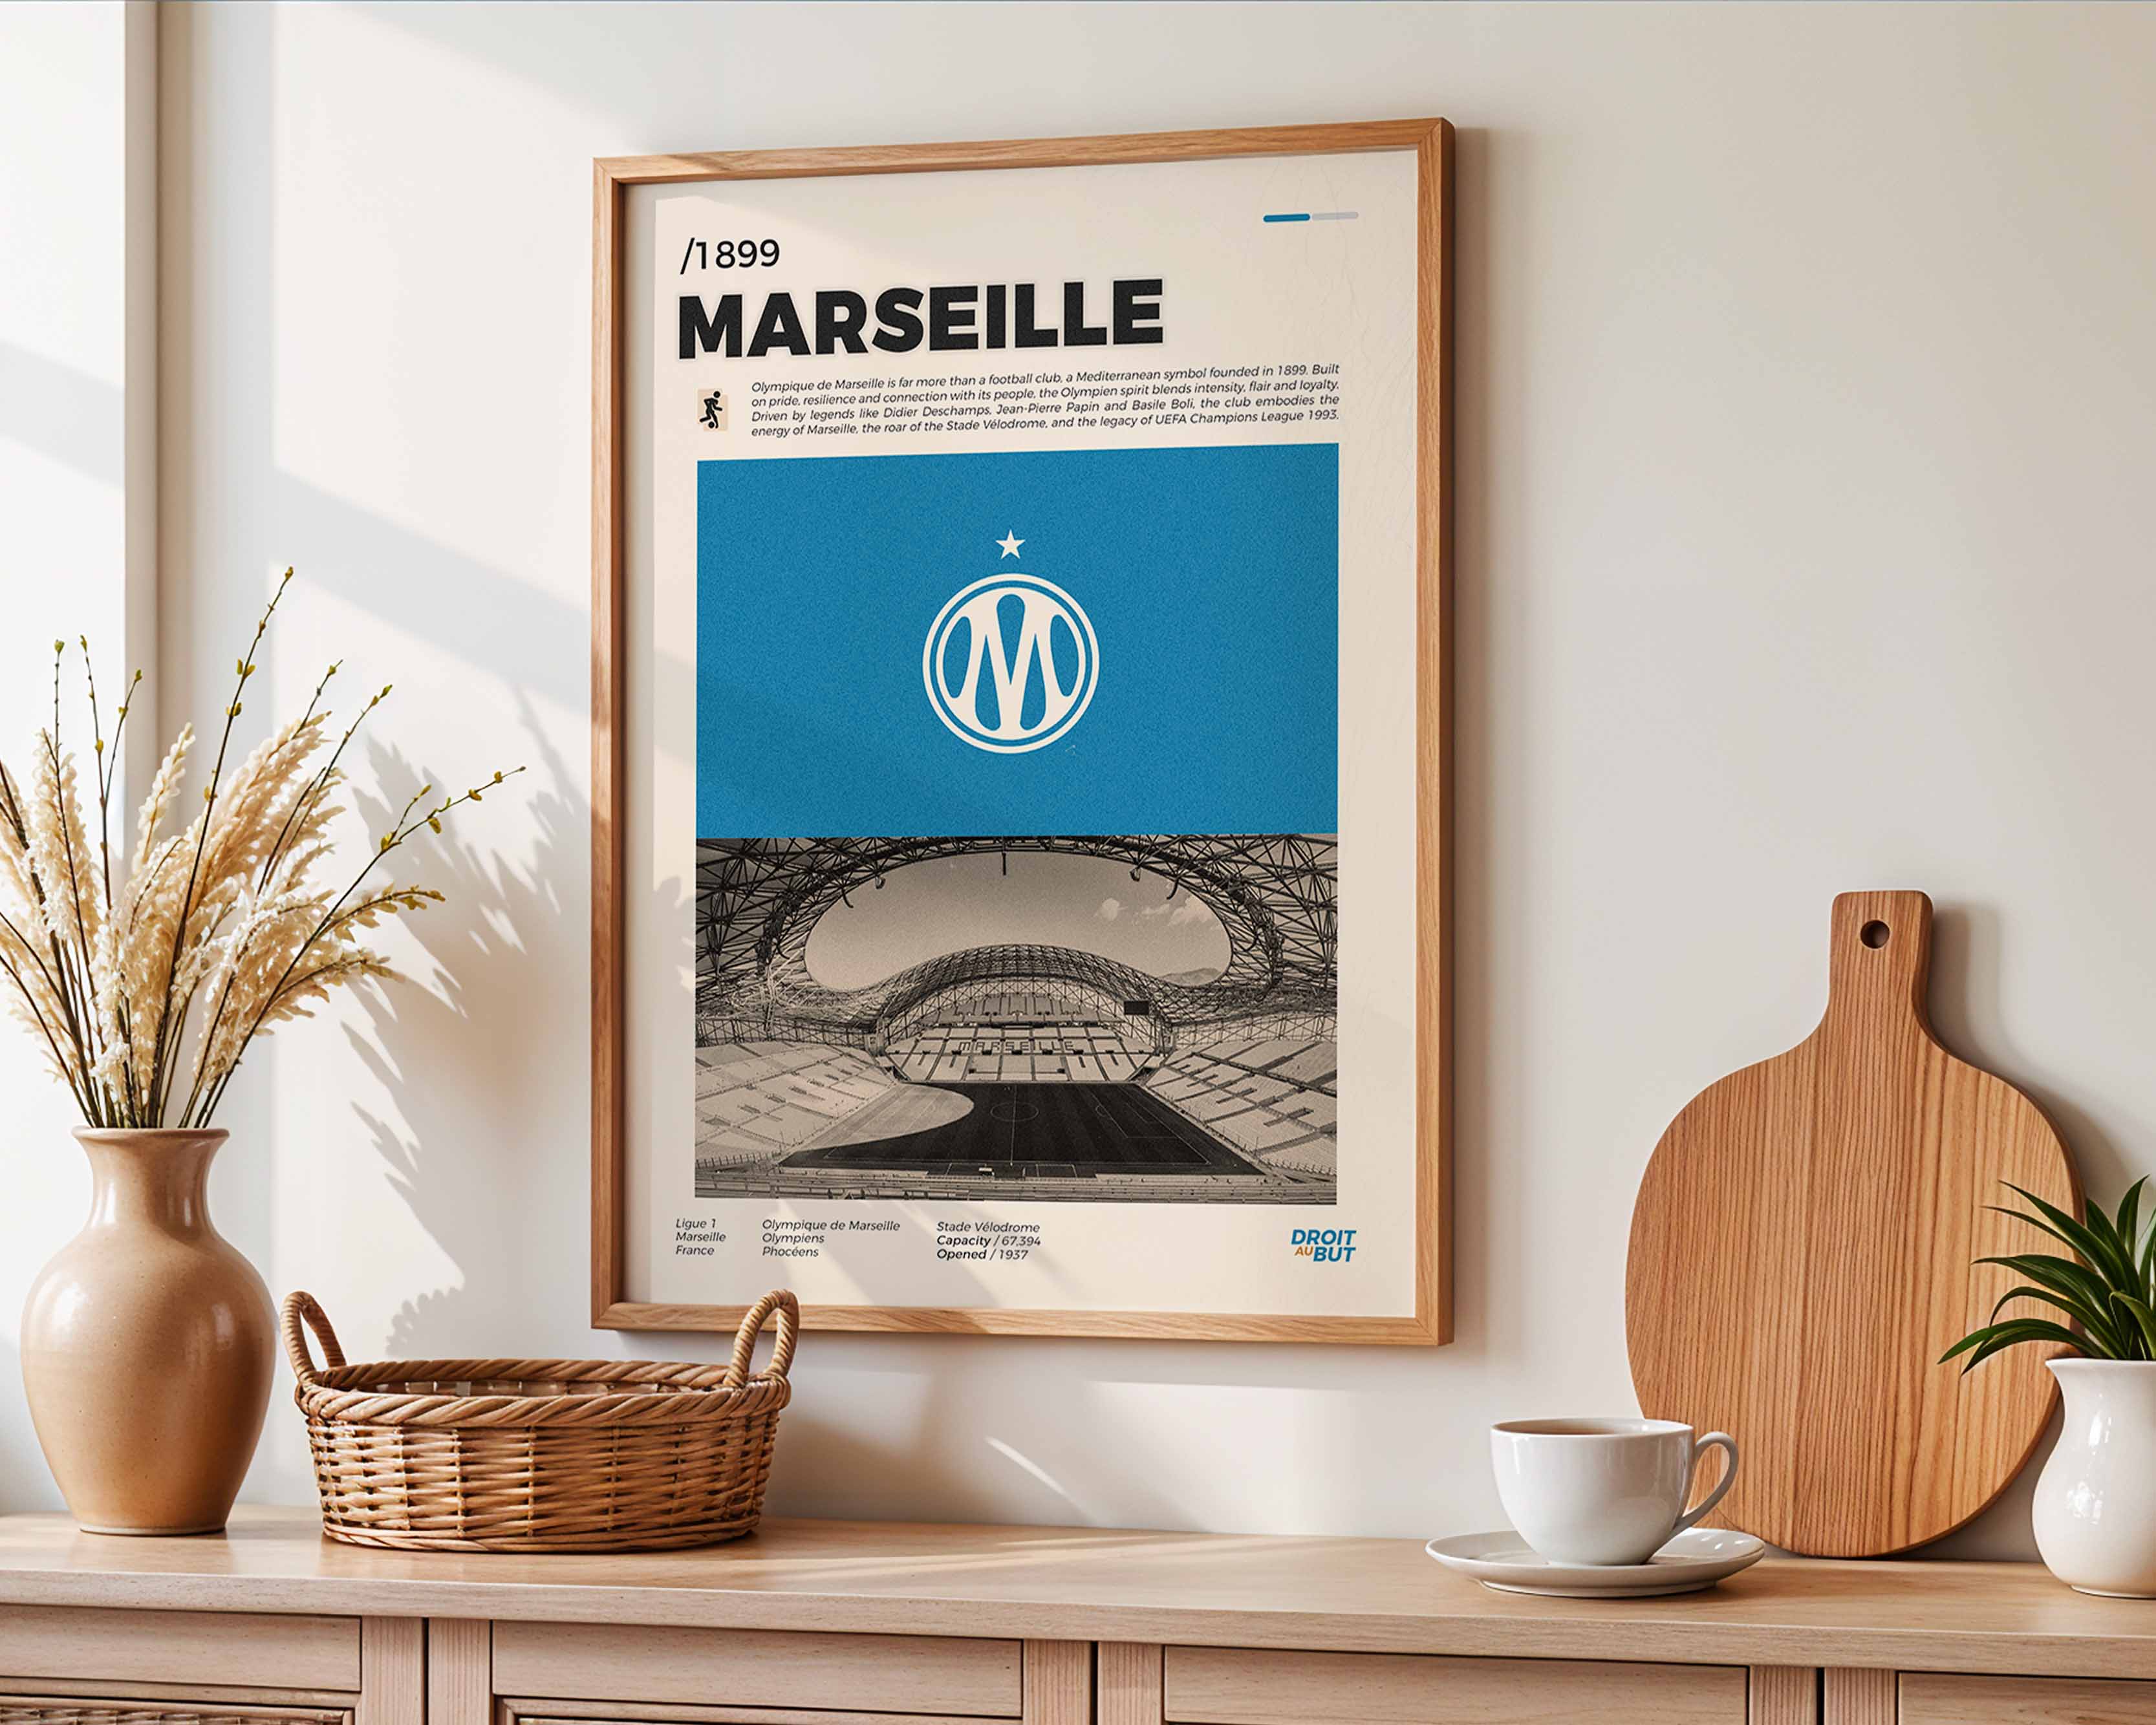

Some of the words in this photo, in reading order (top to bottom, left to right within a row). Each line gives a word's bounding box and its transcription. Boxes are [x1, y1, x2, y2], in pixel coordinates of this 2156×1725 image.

[680, 237, 780, 275] /1899
[678, 279, 1163, 359] MARSEILLE
[751, 380, 815, 395] Olympique
[817, 380, 832, 391] de
[834, 378, 885, 390] Marseille
[887, 377, 896, 389] is
[898, 376, 914, 388] far
[916, 378, 947, 387] more
[949, 375, 976, 387] than
[978, 376, 986, 385] a
[989, 372, 1033, 385] football
[1066, 374, 1073, 383] a
[1076, 370, 1161, 382] Mediterranean
[1163, 367, 1207, 382] symbol
[1209, 365, 1260, 378] founded
[1262, 365, 1274, 376] in
[1311, 363, 1340, 375] Built
[751, 398, 766, 407] on
[803, 394, 856, 406] resilience
[858, 392, 881, 404] and
[883, 391, 948, 403] connection
[950, 389, 976, 401] with
[978, 389, 991, 400] its
[1039, 387, 1059, 398] the
[1060, 385, 1118, 400] Olympien
[1119, 384, 1150, 398] spirit
[1152, 383, 1192, 395] blends
[1249, 380, 1271, 392] flair
[1273, 380, 1298, 392] and
[751, 411, 788, 422] Driven
[792, 410, 806, 423] by
[810, 409, 855, 422] legends
[859, 407, 879, 419] like
[883, 406, 919, 418] Didier
[995, 402, 1062, 415] Jean-Pierre
[1066, 401, 1100, 414] Papin
[1104, 400, 1128, 412] and
[1132, 399, 1167, 411] Basile
[1200, 397, 1220, 409] the
[1223, 396, 1251, 409] club
[1255, 394, 1315, 408] embodies
[1320, 394, 1340, 405] the
[751, 427, 791, 438] energy
[792, 424, 806, 436] of
[862, 422, 881, 434] the
[884, 423, 908, 433] roar
[909, 420, 923, 432] of
[924, 420, 944, 432] the
[945, 419, 980, 431] Stade
[1051, 416, 1075, 428] and
[1077, 416, 1097, 427] the
[1099, 416, 1138, 429] legacy
[1139, 414, 1154, 425] of
[1155, 413, 1187, 425] UEFA
[1189, 411, 1258, 425] Champions
[1261, 411, 1304, 424] League
[958, 1041, 1074, 1051] MARSEILLE
[676, 1217, 707, 1231] Ligue
[711, 1218, 716, 1228] 1
[762, 1219, 827, 1232] Olympique
[830, 1219, 846, 1231] de
[848, 1220, 901, 1231] Marseille
[936, 1221, 971, 1232] Stade
[975, 1221, 1040, 1232] Vélodrome
[675, 1231, 726, 1243] Marseille
[762, 1232, 825, 1245] Olympiens
[936, 1235, 991, 1248] Capacity
[993, 1234, 1000, 1247] /
[1291, 1230, 1357, 1245] DROIT
[675, 1245, 715, 1256] France
[762, 1245, 819, 1258] Phocéens
[936, 1248, 987, 1261] Opened
[989, 1248, 997, 1261] /
[999, 1249, 1029, 1260] 1937
[1295, 1246, 1313, 1256] AU
[1313, 1247, 1356, 1262] BUT
